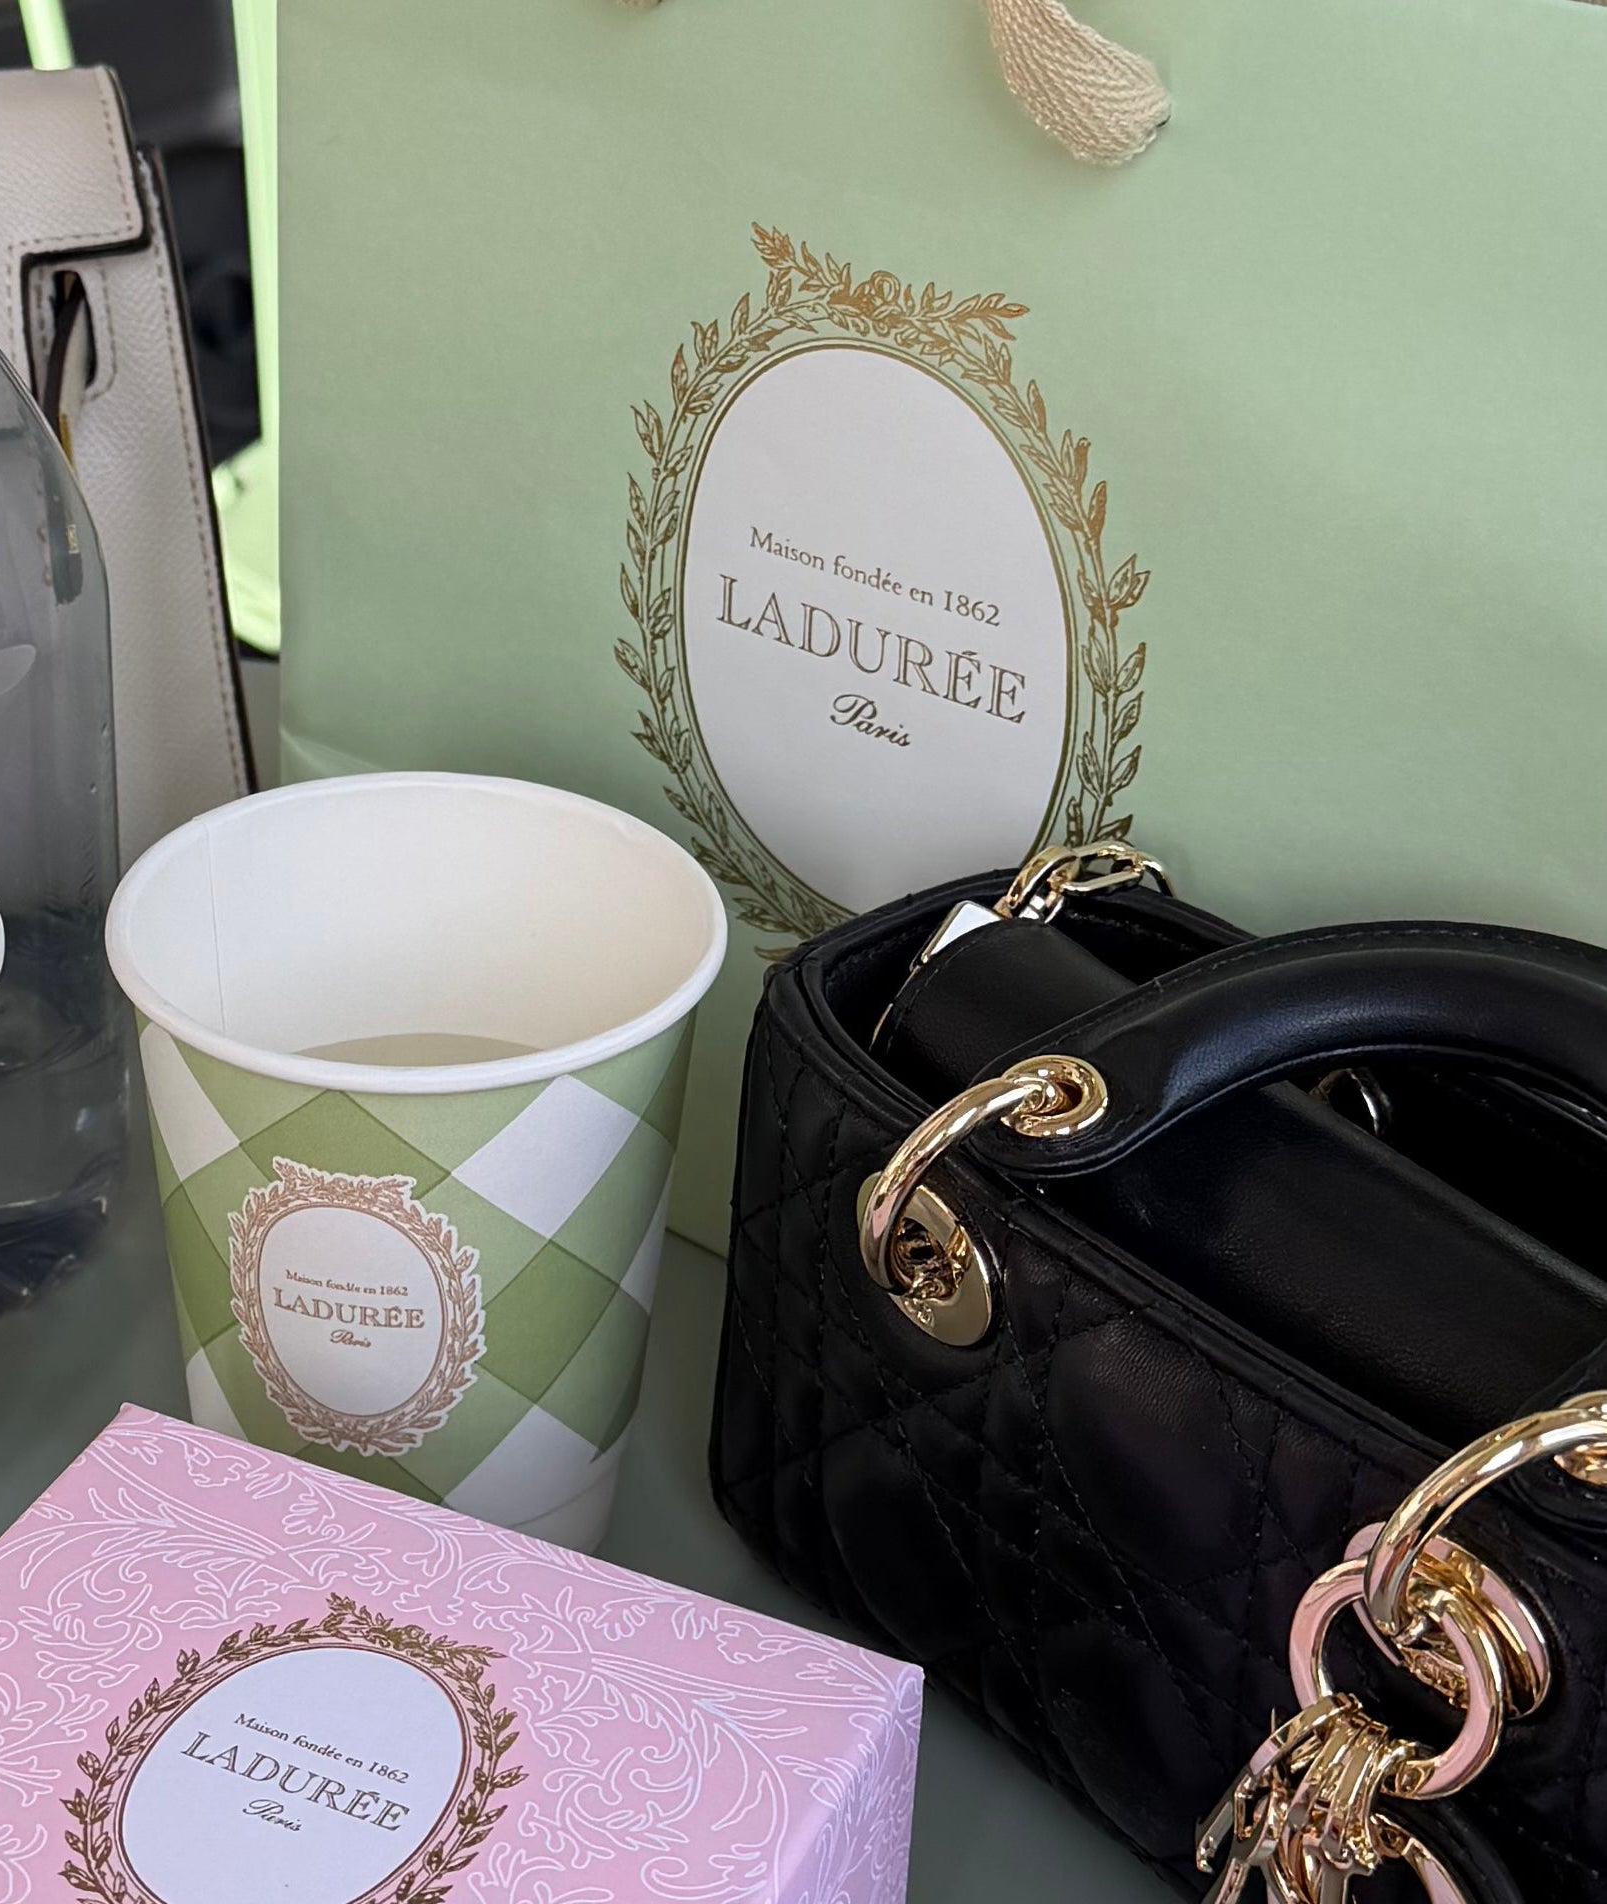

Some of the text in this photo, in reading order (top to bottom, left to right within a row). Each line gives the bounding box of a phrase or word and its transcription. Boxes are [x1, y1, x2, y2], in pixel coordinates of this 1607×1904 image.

[749, 526, 1001, 627] Maison fondée en 1862
[716, 573, 1027, 725] LADURÉE
[829, 693, 911, 748] Paris
[272, 1287, 426, 1329] LADURÉE
[380, 1286, 409, 1297] 1862
[233, 1712, 411, 1784] Maison fondée en 1862
[180, 1730, 411, 1832] LADURÉE
[242, 1798, 303, 1832] Paris
